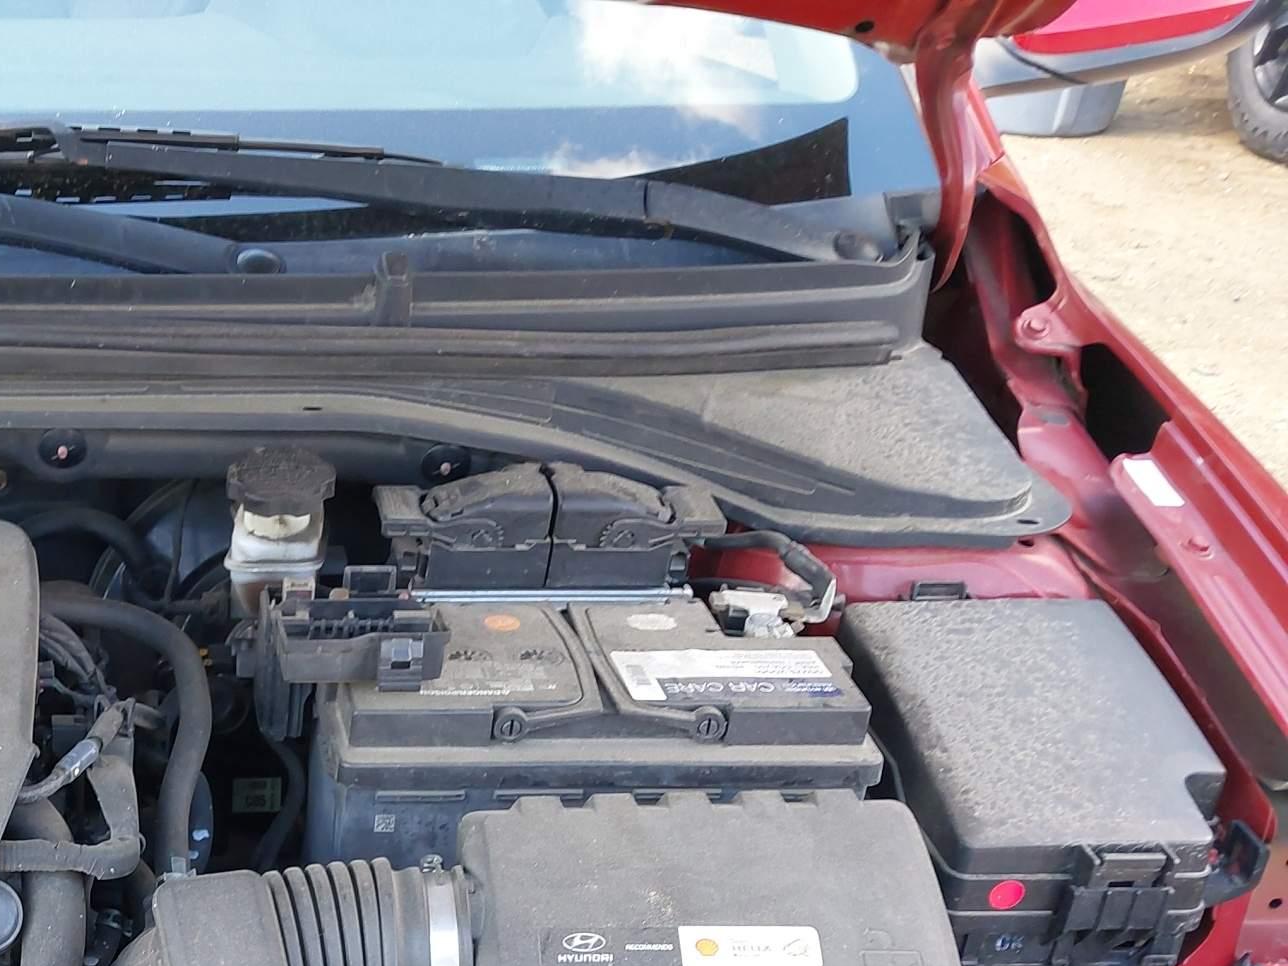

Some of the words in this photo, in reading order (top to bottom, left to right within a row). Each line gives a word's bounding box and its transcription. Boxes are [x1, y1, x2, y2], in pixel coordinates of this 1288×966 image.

[663, 682, 724, 694] CARE
[728, 681, 776, 693] CAR
[557, 953, 615, 964] HYUNDAI
